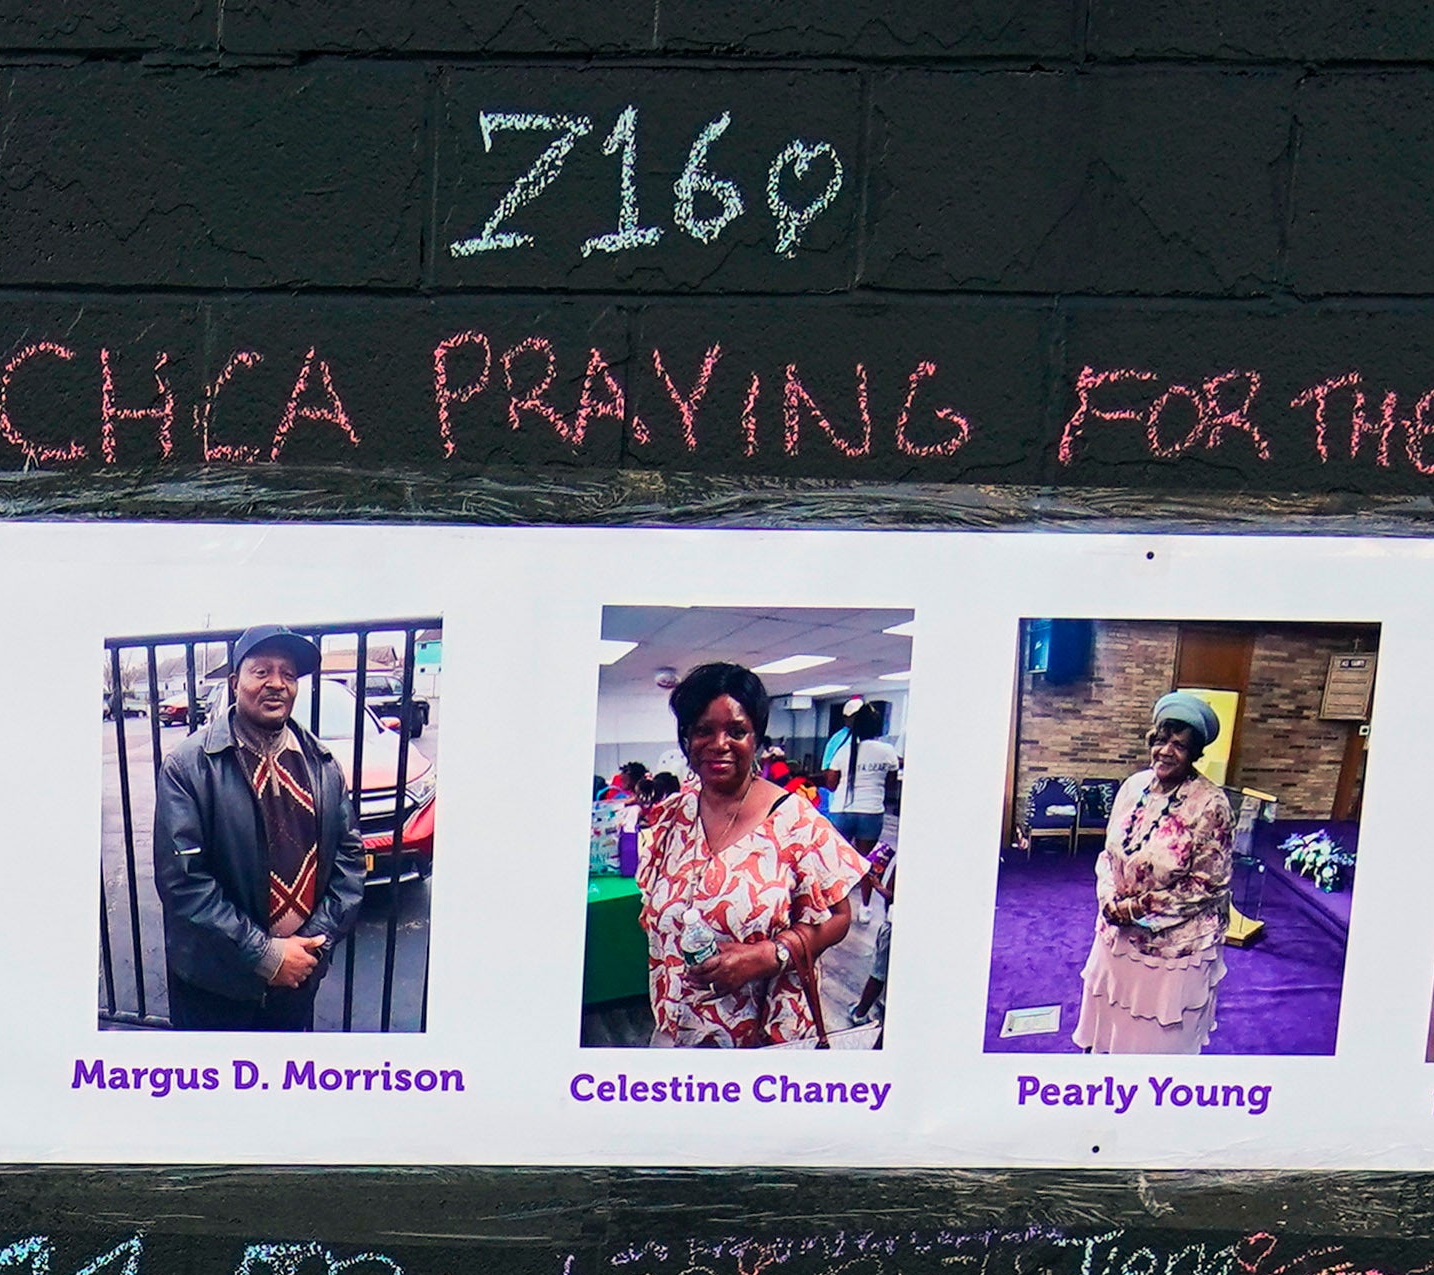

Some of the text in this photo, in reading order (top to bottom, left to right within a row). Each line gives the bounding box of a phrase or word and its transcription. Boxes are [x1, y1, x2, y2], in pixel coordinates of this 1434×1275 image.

[433, 330, 972, 459] PRAYING
[1057, 365, 1270, 465] FOR
[71, 1059, 466, 1098] Margus D. Morrison
[569, 1073, 892, 1111] Celestine Chaney
[1016, 1075, 1273, 1116] Pearly Young
